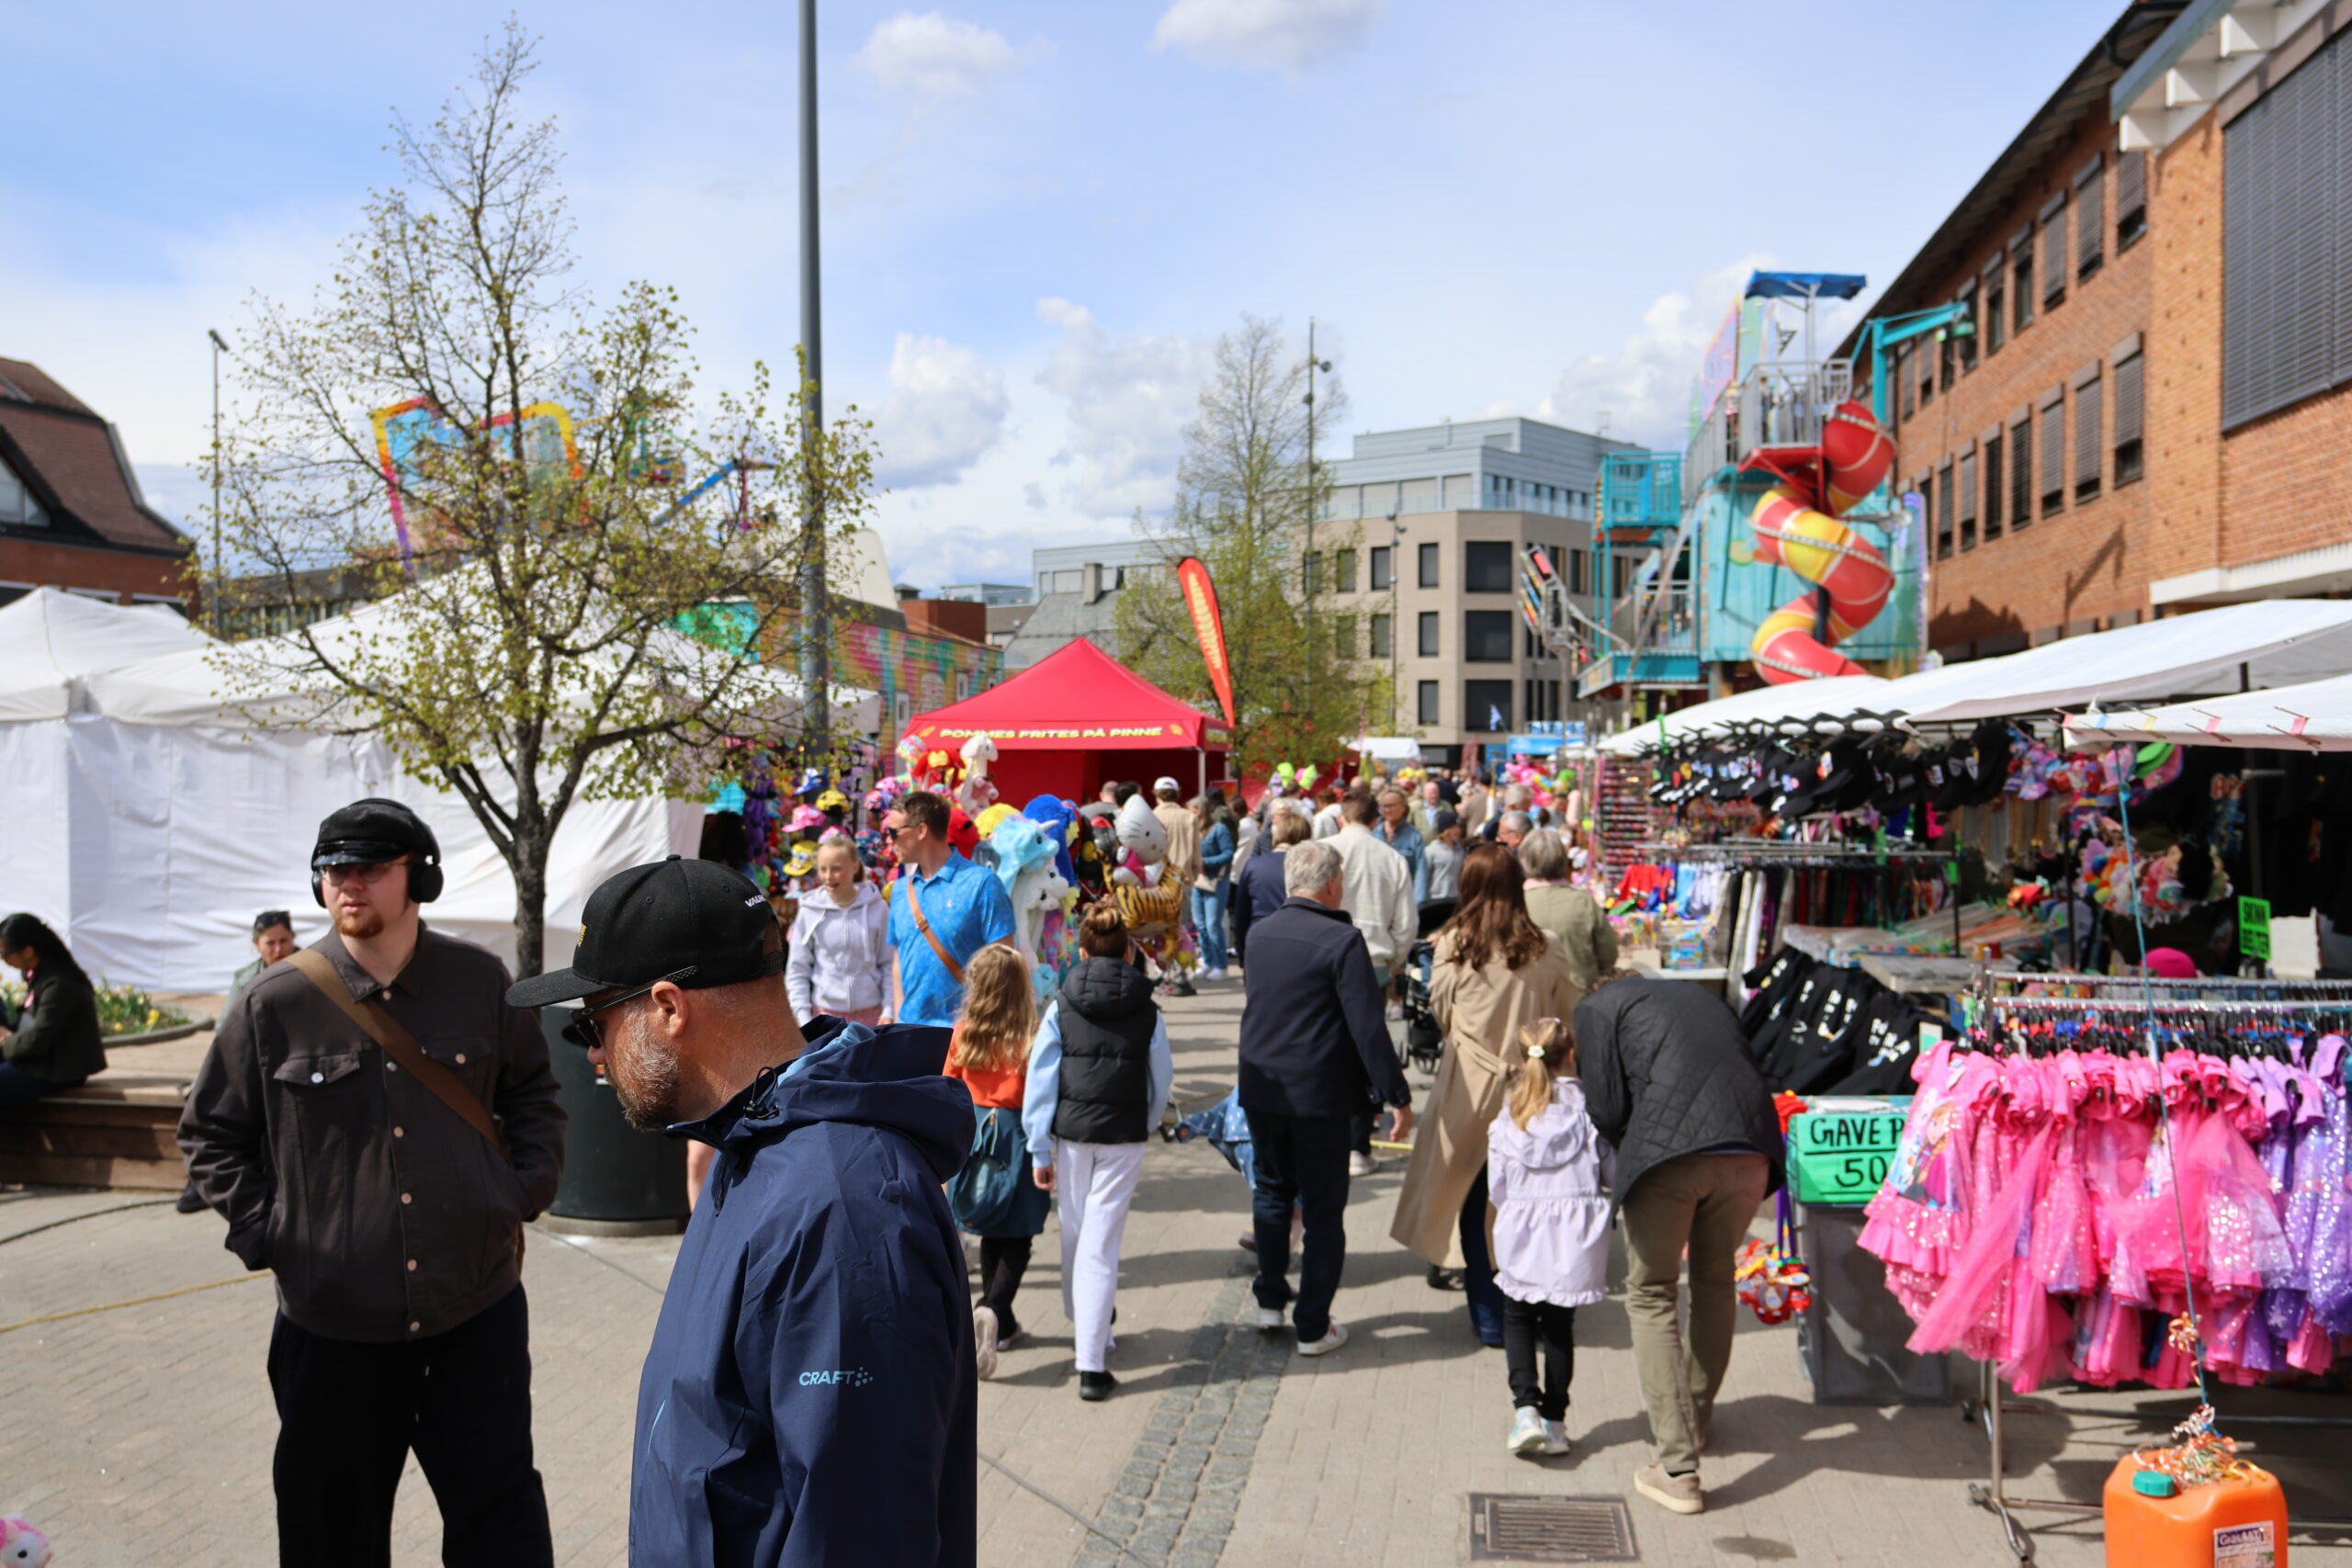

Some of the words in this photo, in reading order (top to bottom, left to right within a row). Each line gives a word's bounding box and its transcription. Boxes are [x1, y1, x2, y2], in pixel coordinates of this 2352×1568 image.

[1018, 728, 1080, 739] FRITES
[1082, 727, 1106, 738] PÅ
[1109, 726, 1163, 738] PINNE
[798, 1370, 855, 1386] CRAFT
